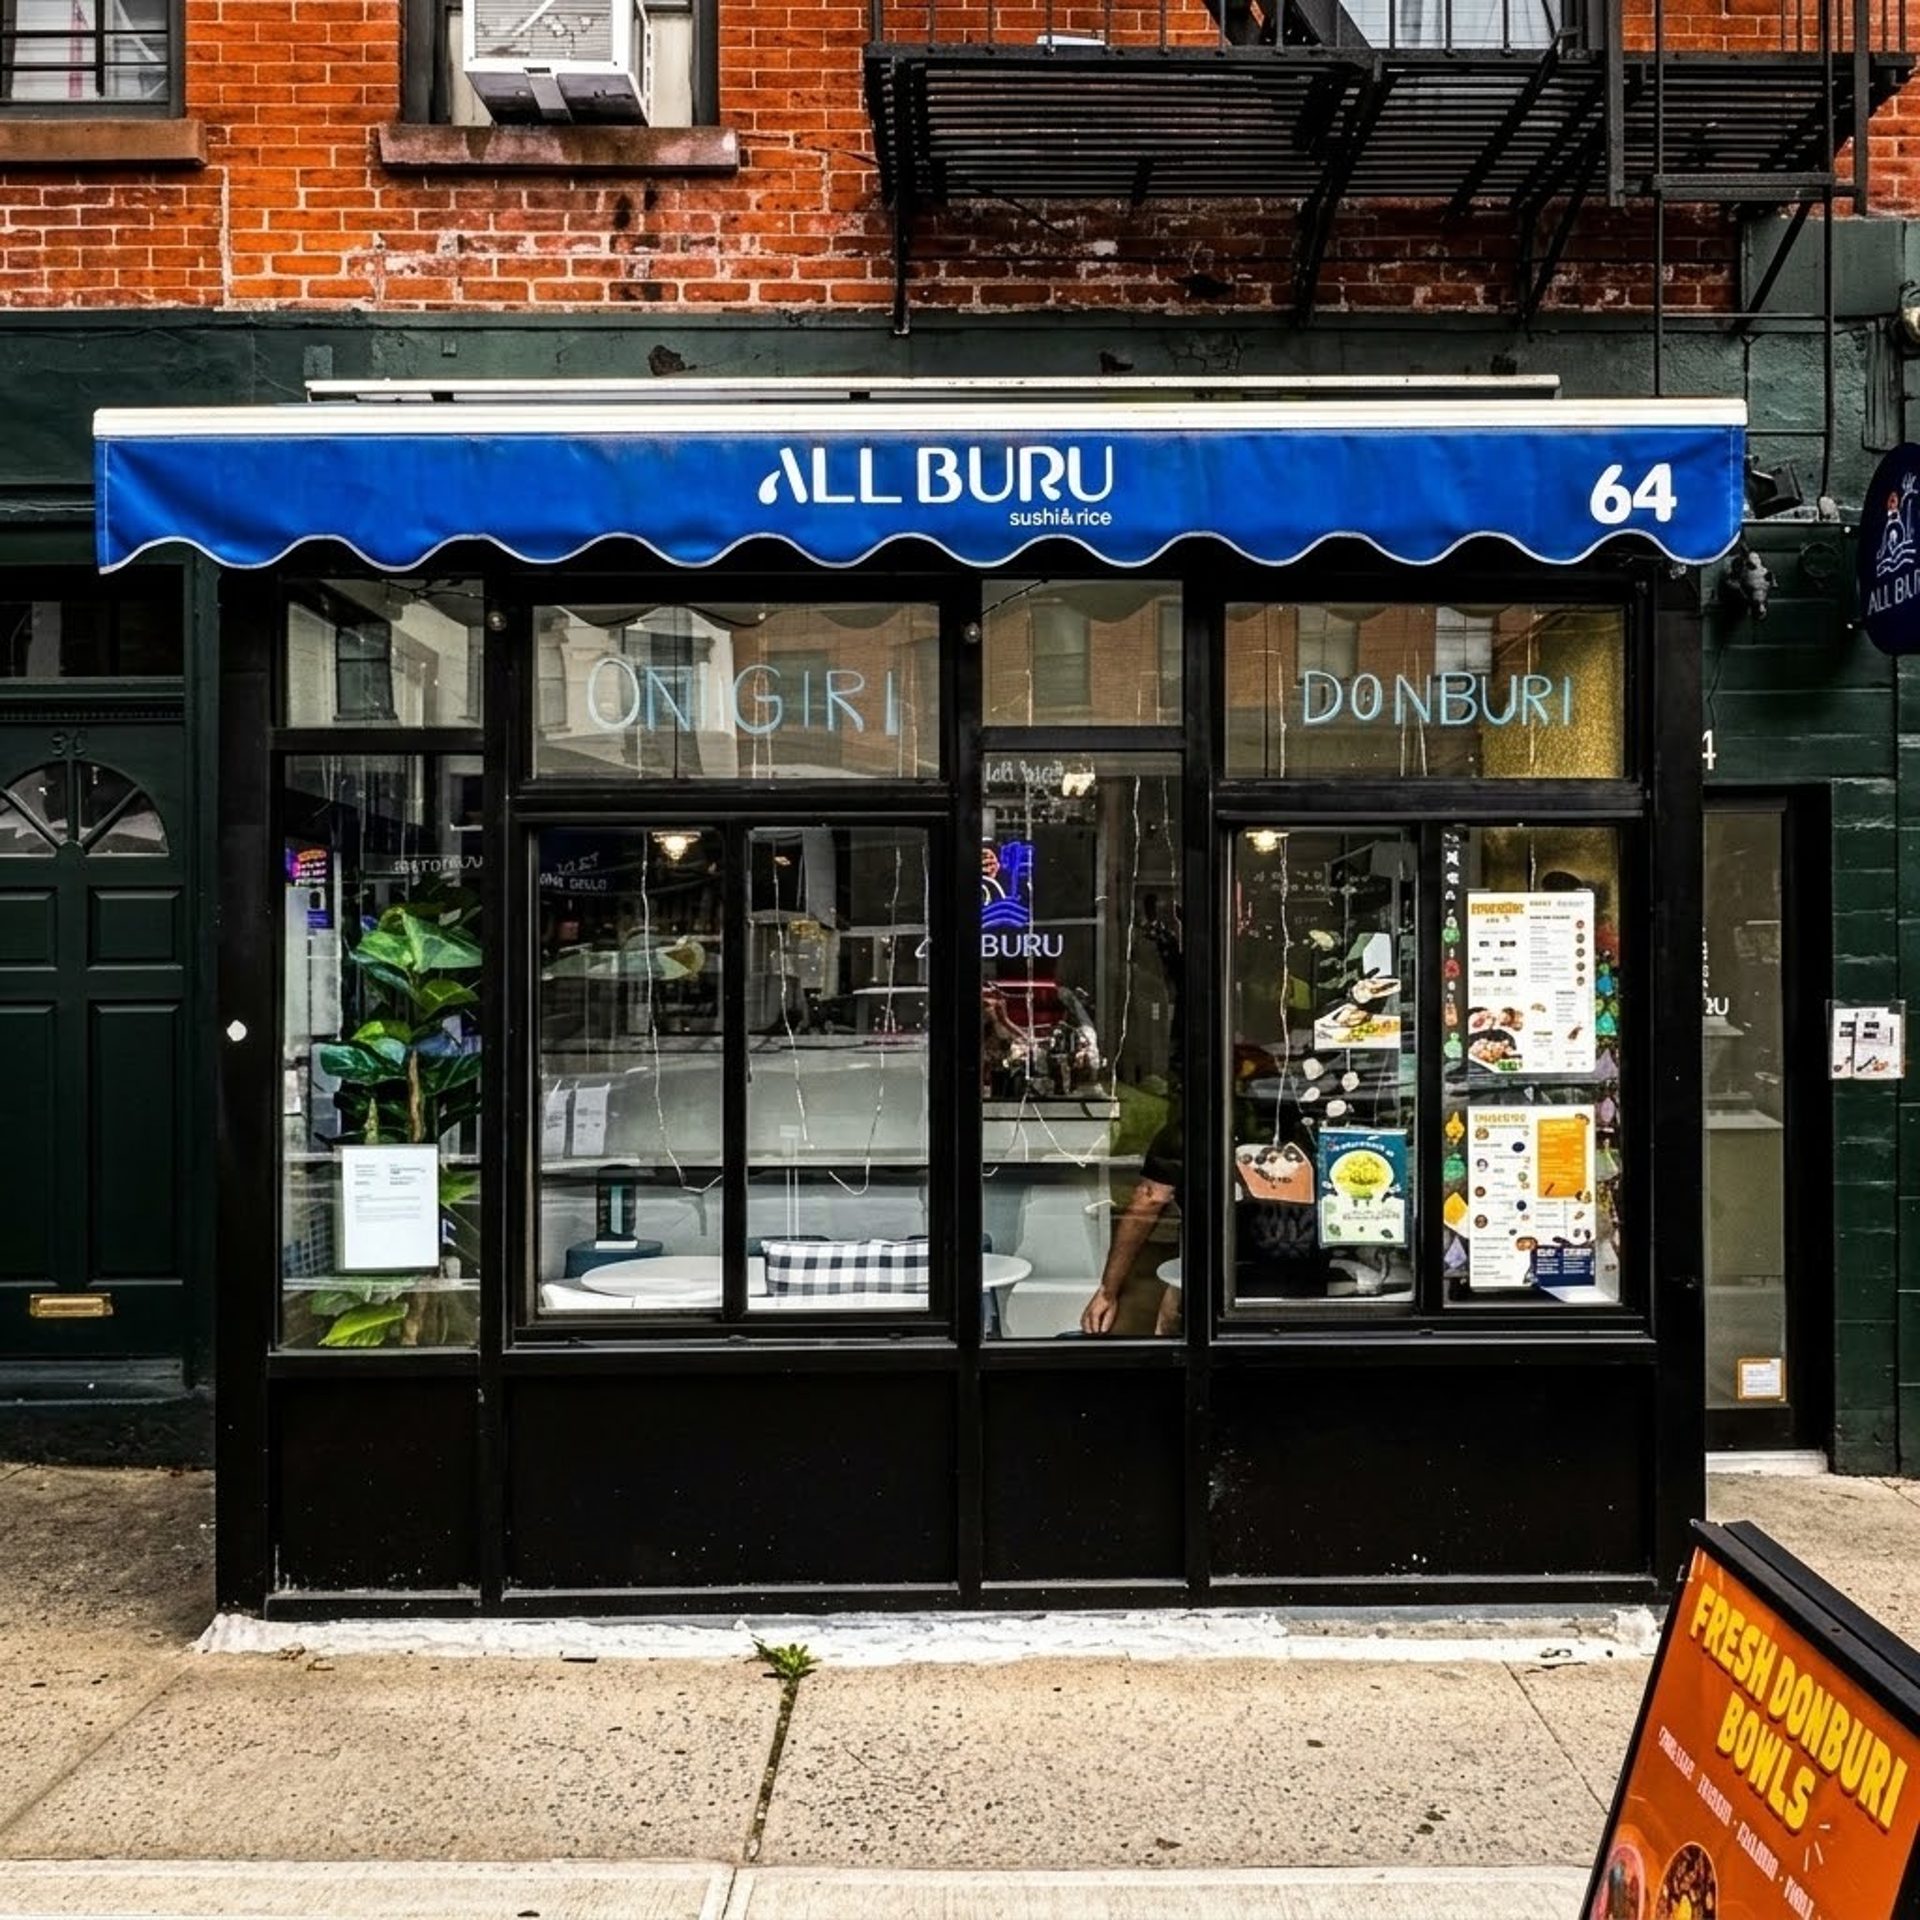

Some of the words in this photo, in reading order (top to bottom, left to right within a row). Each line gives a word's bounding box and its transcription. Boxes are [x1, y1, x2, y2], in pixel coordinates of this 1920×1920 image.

[758, 447, 902, 505] ALL
[917, 446, 1113, 503] BURU
[1588, 462, 1677, 524] 64
[1867, 584, 1893, 616] ALL
[587, 657, 900, 736] ONIGIRI
[1302, 671, 1571, 725] DONBURI
[980, 933, 1064, 957] BURU
[1689, 1583, 1778, 1702] FRESH
[1768, 1654, 1908, 1832] DONBURI
[1716, 1690, 1816, 1832] BOWLS
